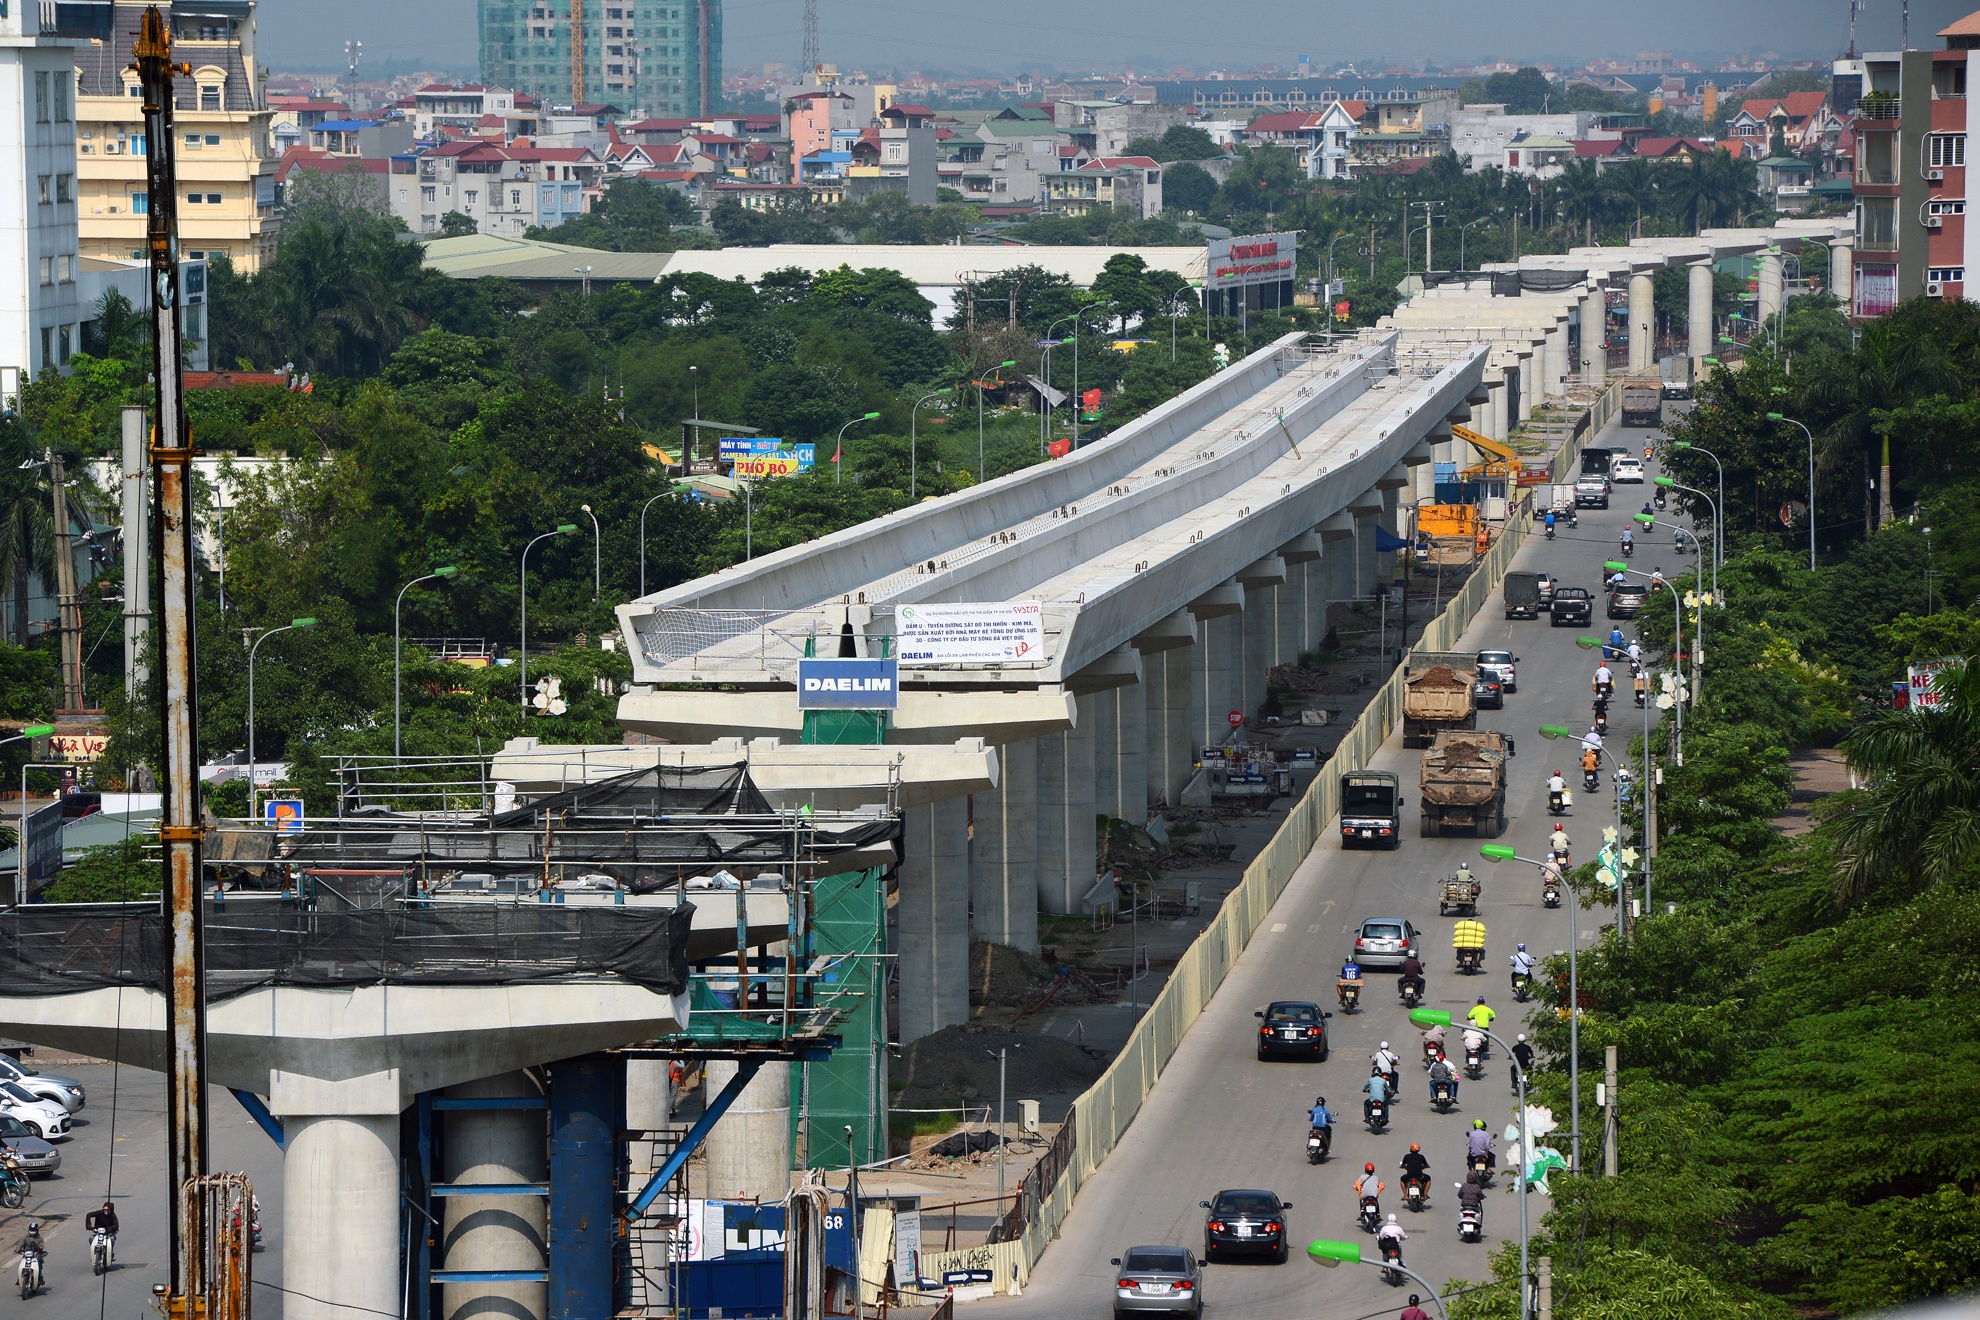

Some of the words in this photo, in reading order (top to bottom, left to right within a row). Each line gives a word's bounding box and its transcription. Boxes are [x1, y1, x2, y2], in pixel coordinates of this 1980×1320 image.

[721, 440, 735, 449] MÁY
[737, 440, 752, 449] TÍNH
[736, 458, 765, 474] PHỞ
[769, 460, 787, 474] BÒ
[804, 678, 891, 691] DAELIM
[1346, 971, 1356, 980] 16
